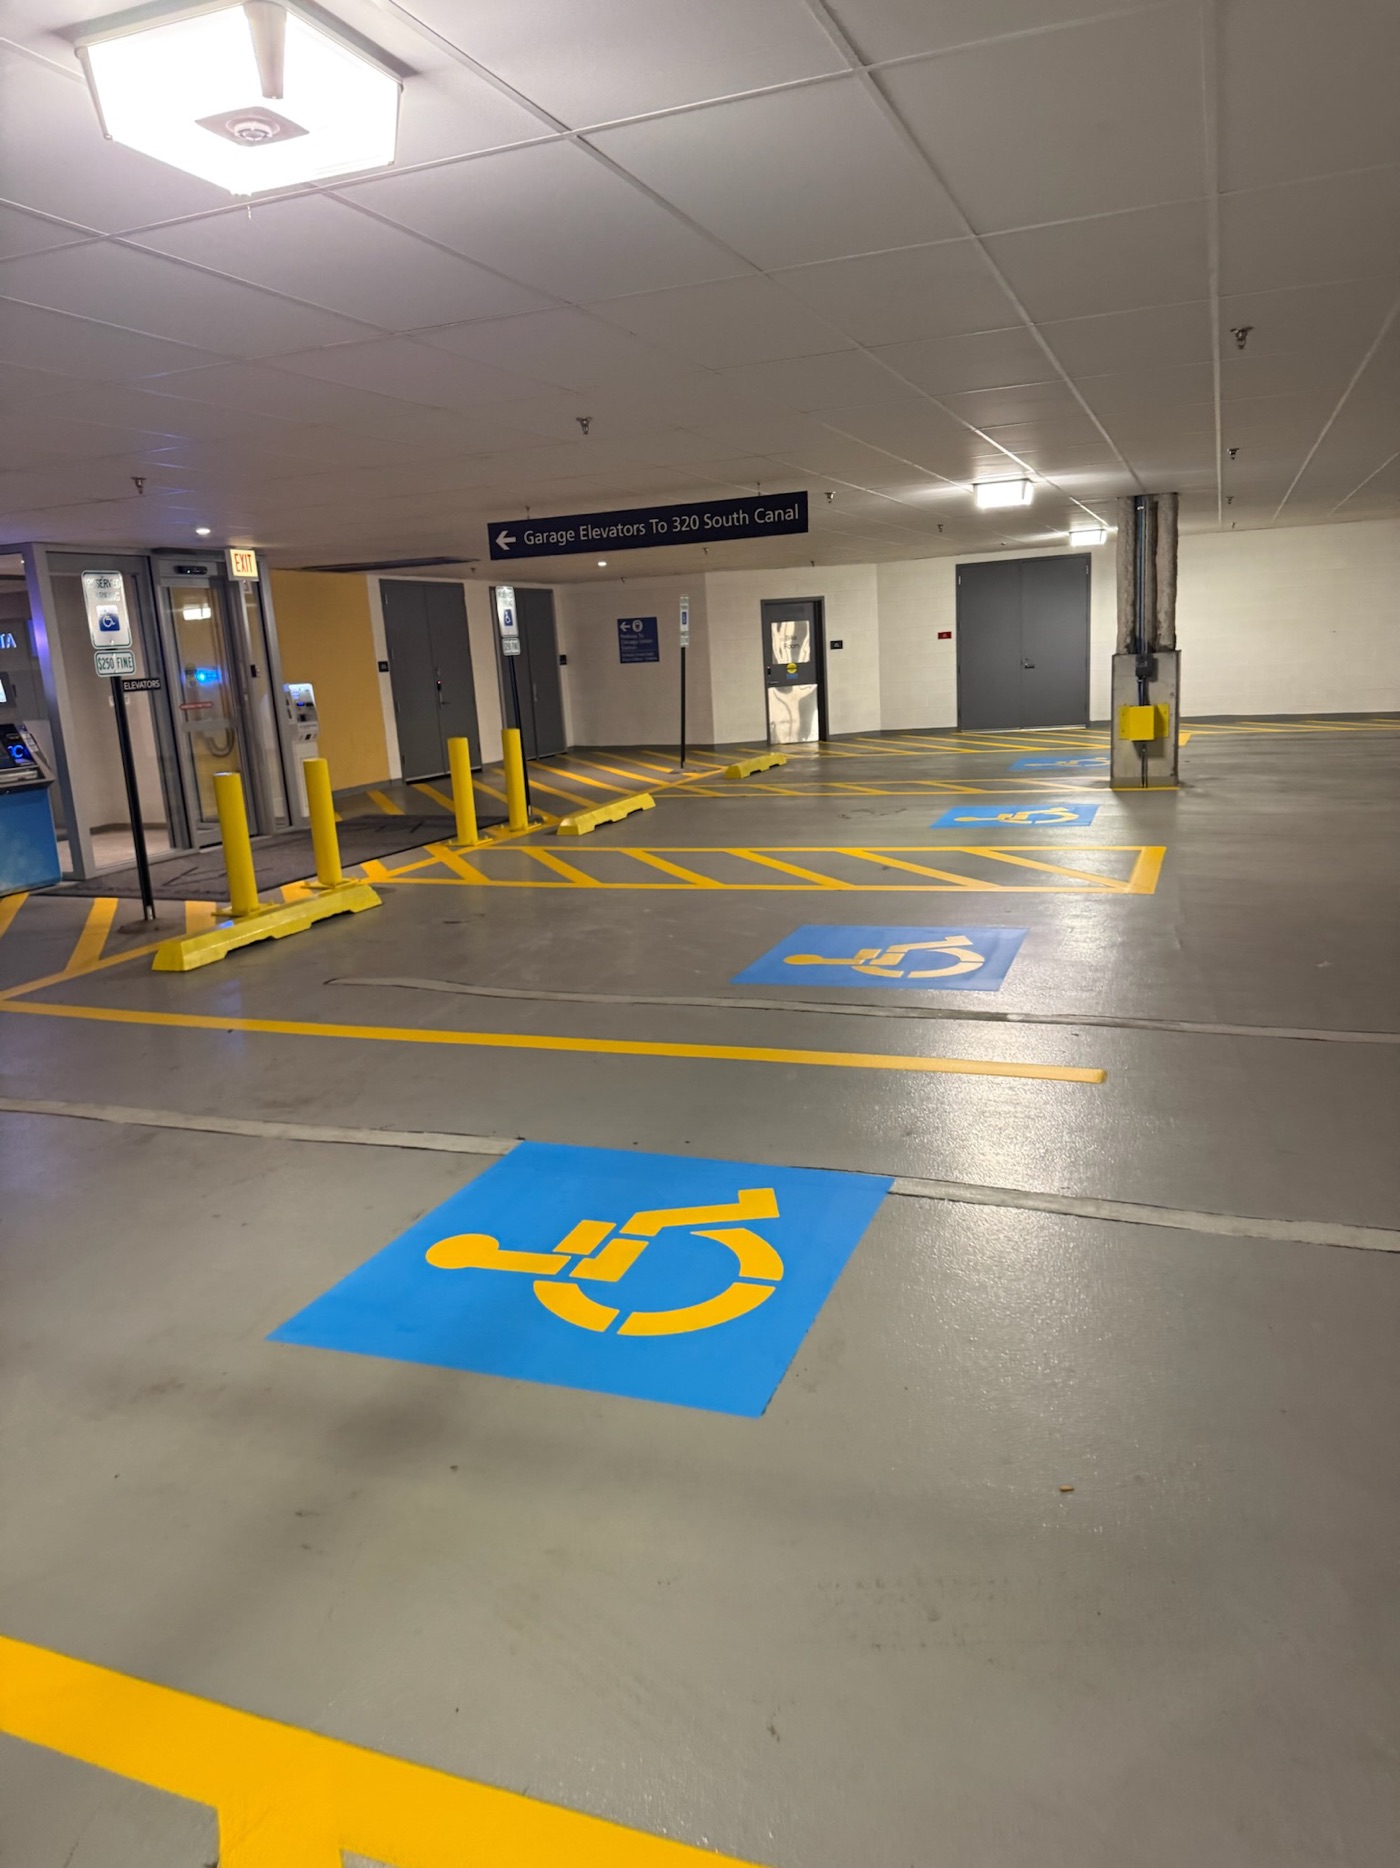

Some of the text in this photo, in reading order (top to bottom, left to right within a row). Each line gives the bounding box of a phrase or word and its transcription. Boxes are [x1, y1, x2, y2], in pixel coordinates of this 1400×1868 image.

[523, 503, 799, 546] Garage Elevators To 320 South Canal
[234, 553, 252, 573] EXIT
[98, 656, 133, 671] $250 FINE
[123, 679, 161, 690] ELEVATORS
